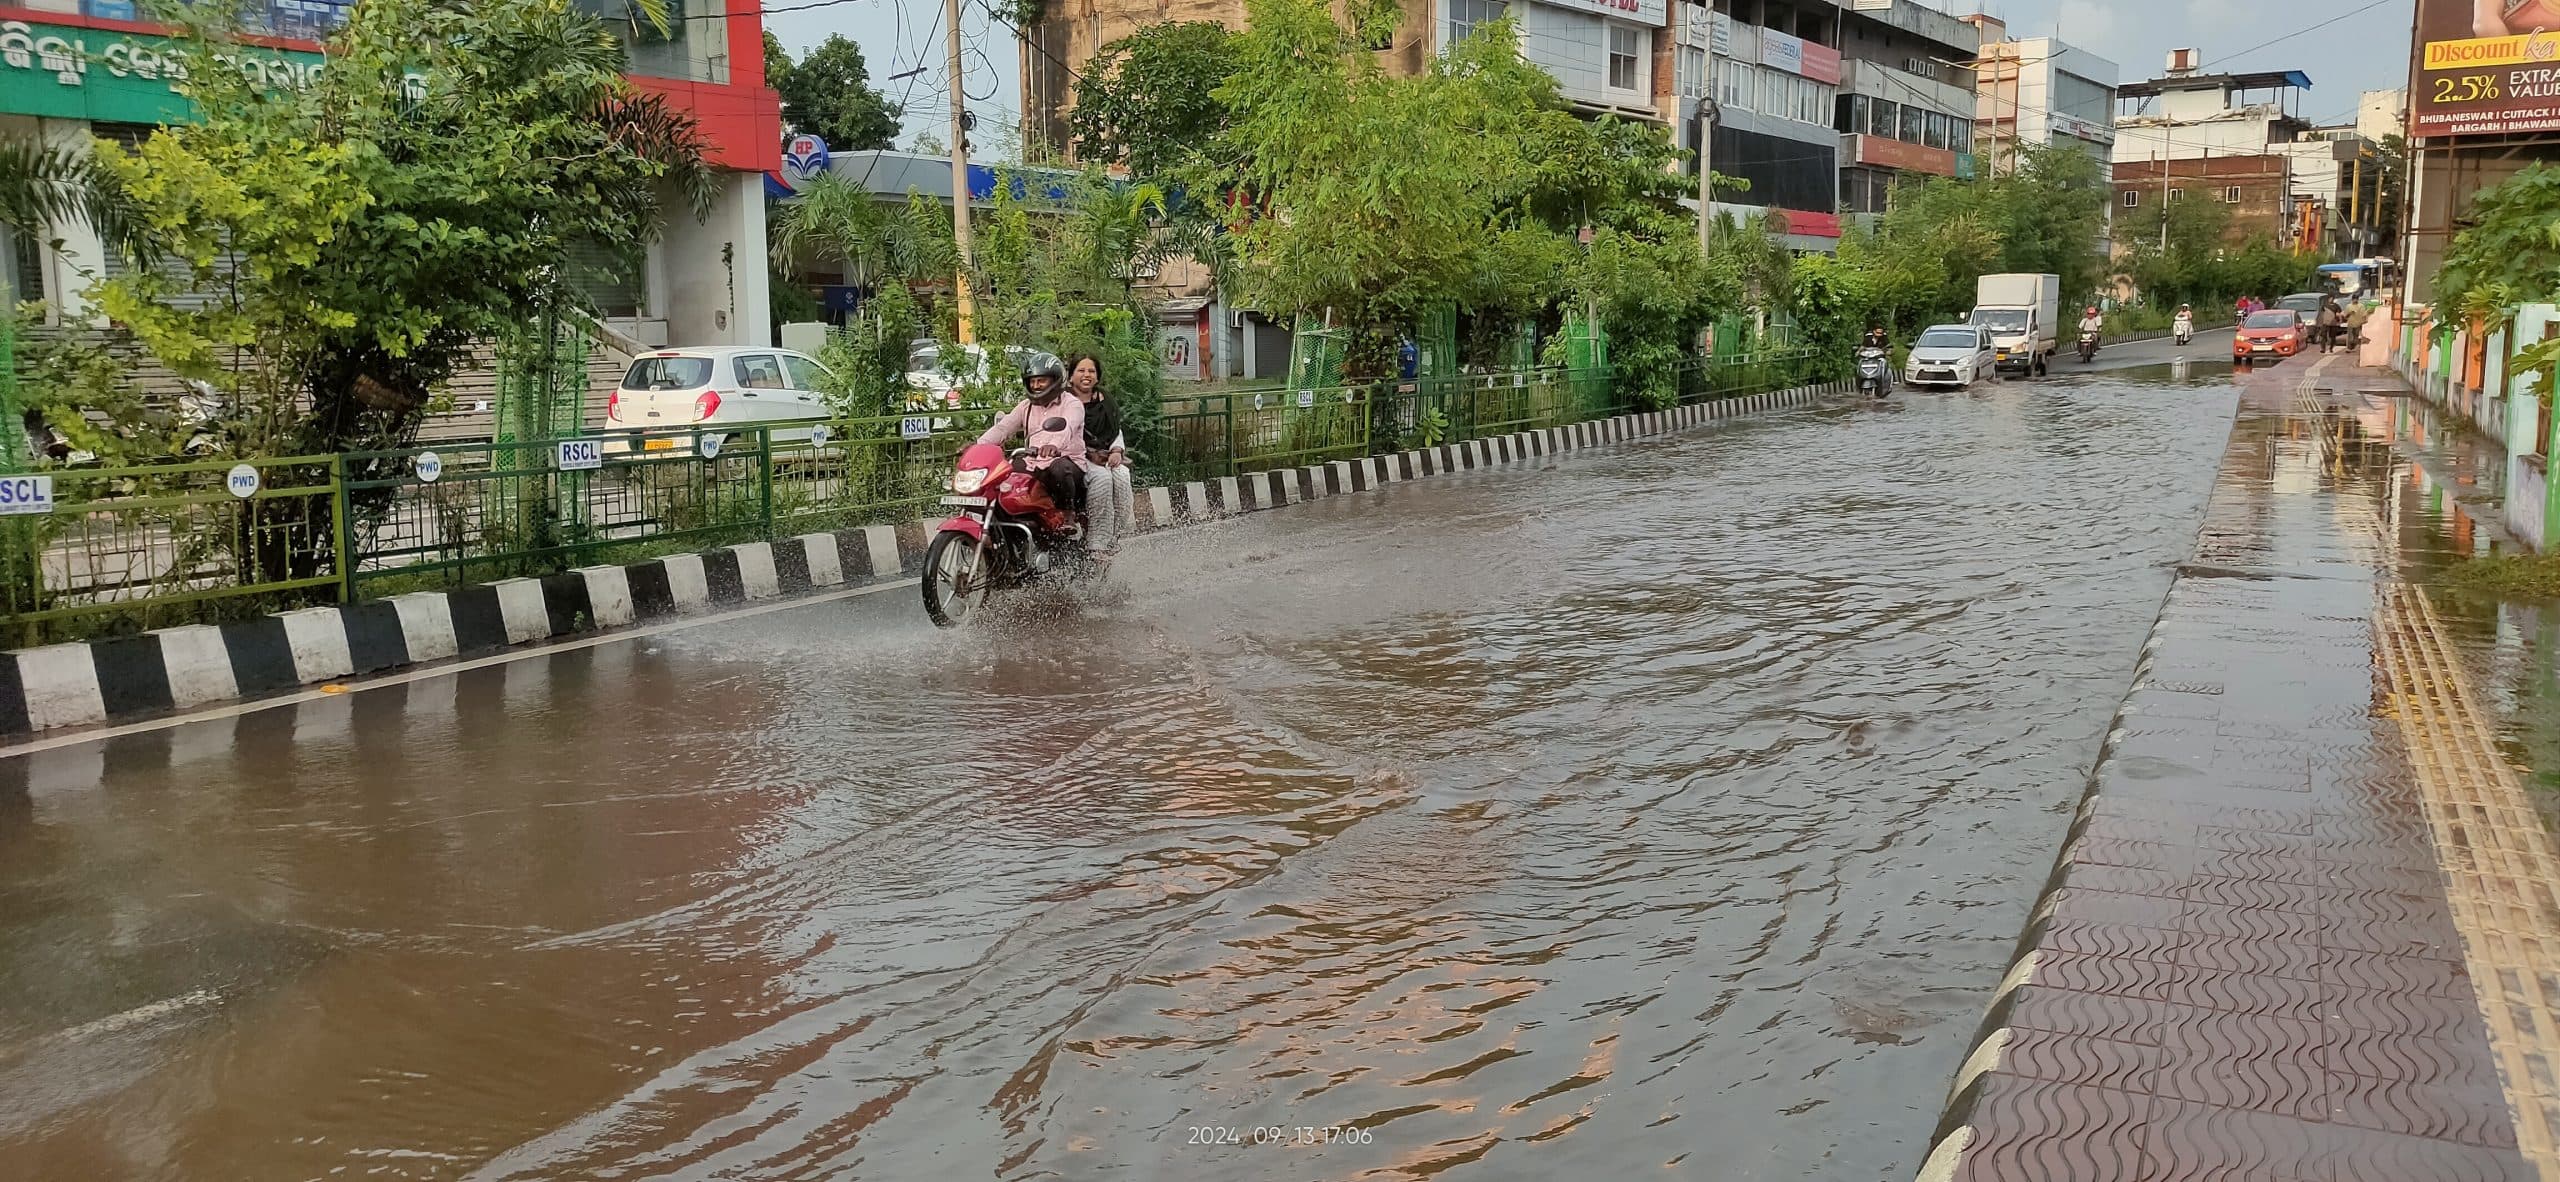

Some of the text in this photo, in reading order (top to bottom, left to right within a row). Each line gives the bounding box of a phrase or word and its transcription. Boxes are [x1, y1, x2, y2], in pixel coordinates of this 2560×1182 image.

[2523, 26, 2557, 60] ka
[2509, 68, 2560, 85] EXTRA
[2433, 74, 2500, 103] 2.5%
[2508, 82, 2560, 98] VALUE
[2420, 111, 2494, 124] BHUBANESWAR
[2502, 108, 2550, 120] CUTTACK
[2451, 123, 2501, 133] BARGARH
[795, 141, 813, 155] HP
[904, 418, 927, 433] RSCL
[813, 430, 826, 441] PWD
[563, 442, 598, 461] RSCL
[703, 439, 718, 450] PWD
[420, 460, 439, 473] PWD
[232, 474, 256, 489] PWD
[0, 479, 45, 503] SCL
